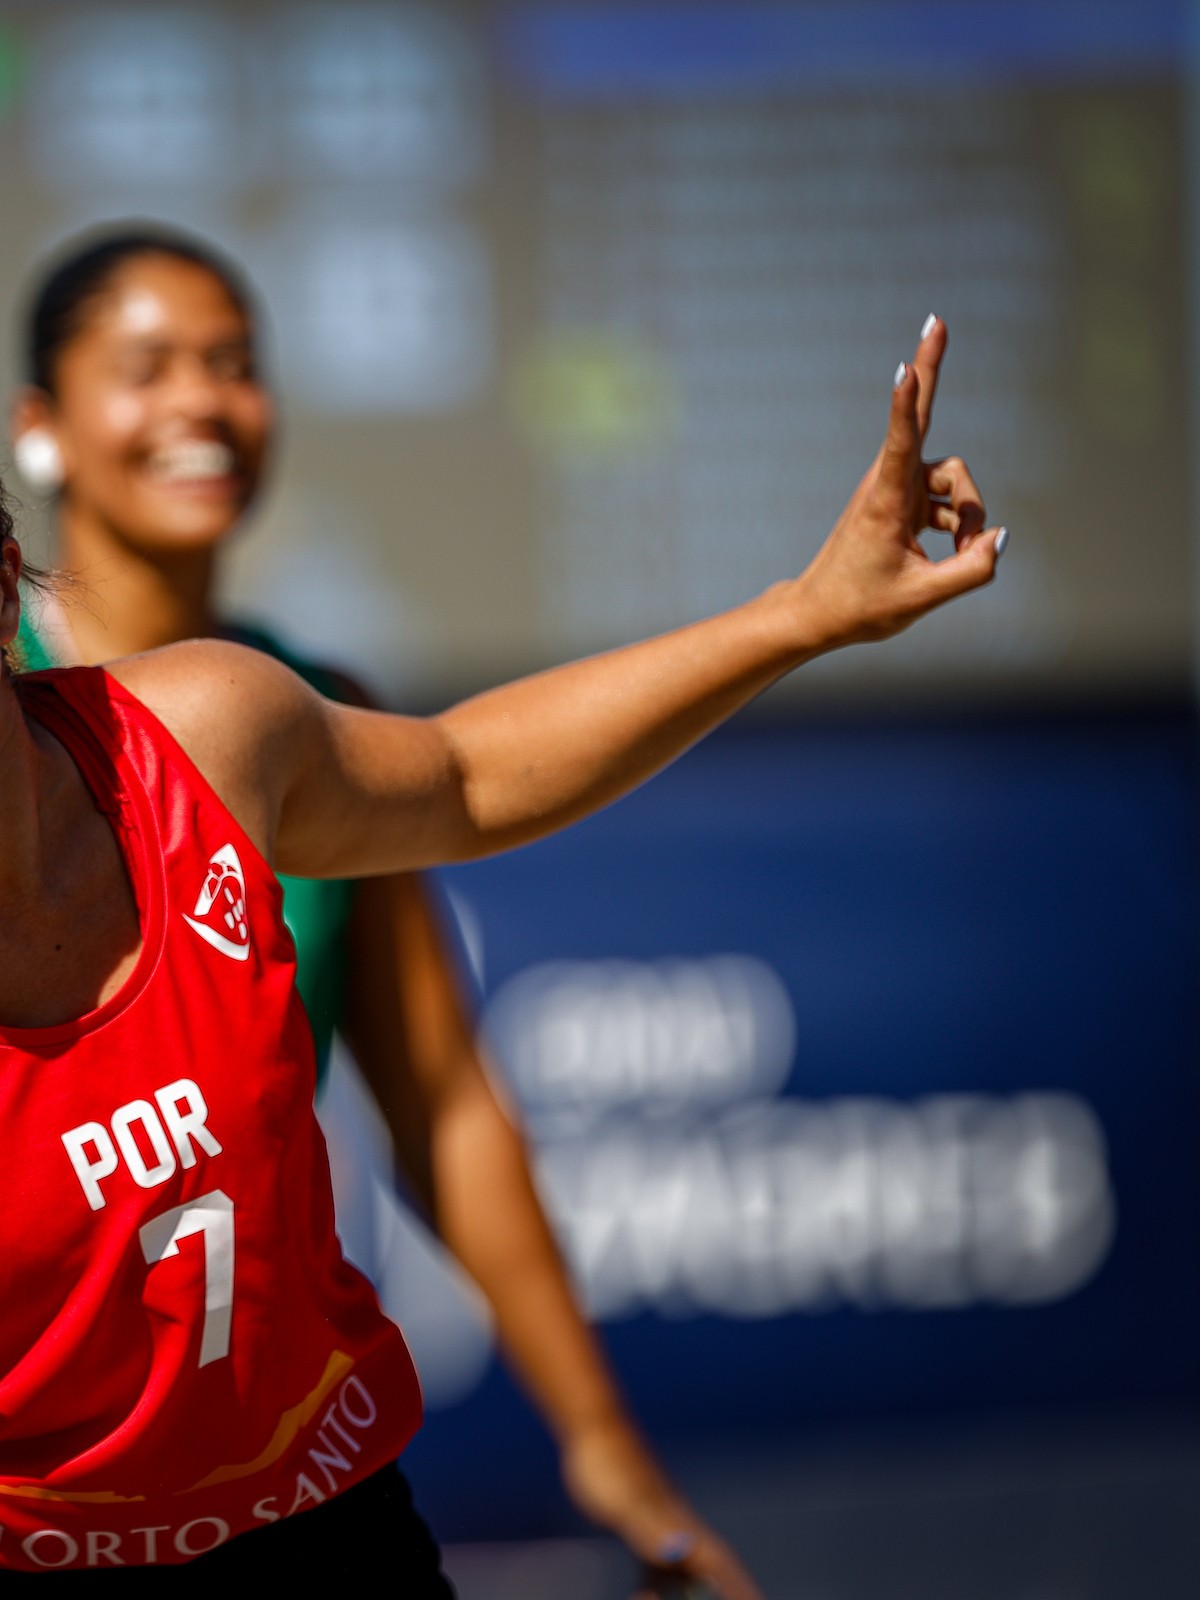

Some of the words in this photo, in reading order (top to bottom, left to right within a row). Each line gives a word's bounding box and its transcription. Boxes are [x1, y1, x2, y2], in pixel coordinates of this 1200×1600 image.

[60, 1078, 223, 1211] POR
[138, 1188, 234, 1369] 7
[252, 1375, 377, 1522] SANTO
